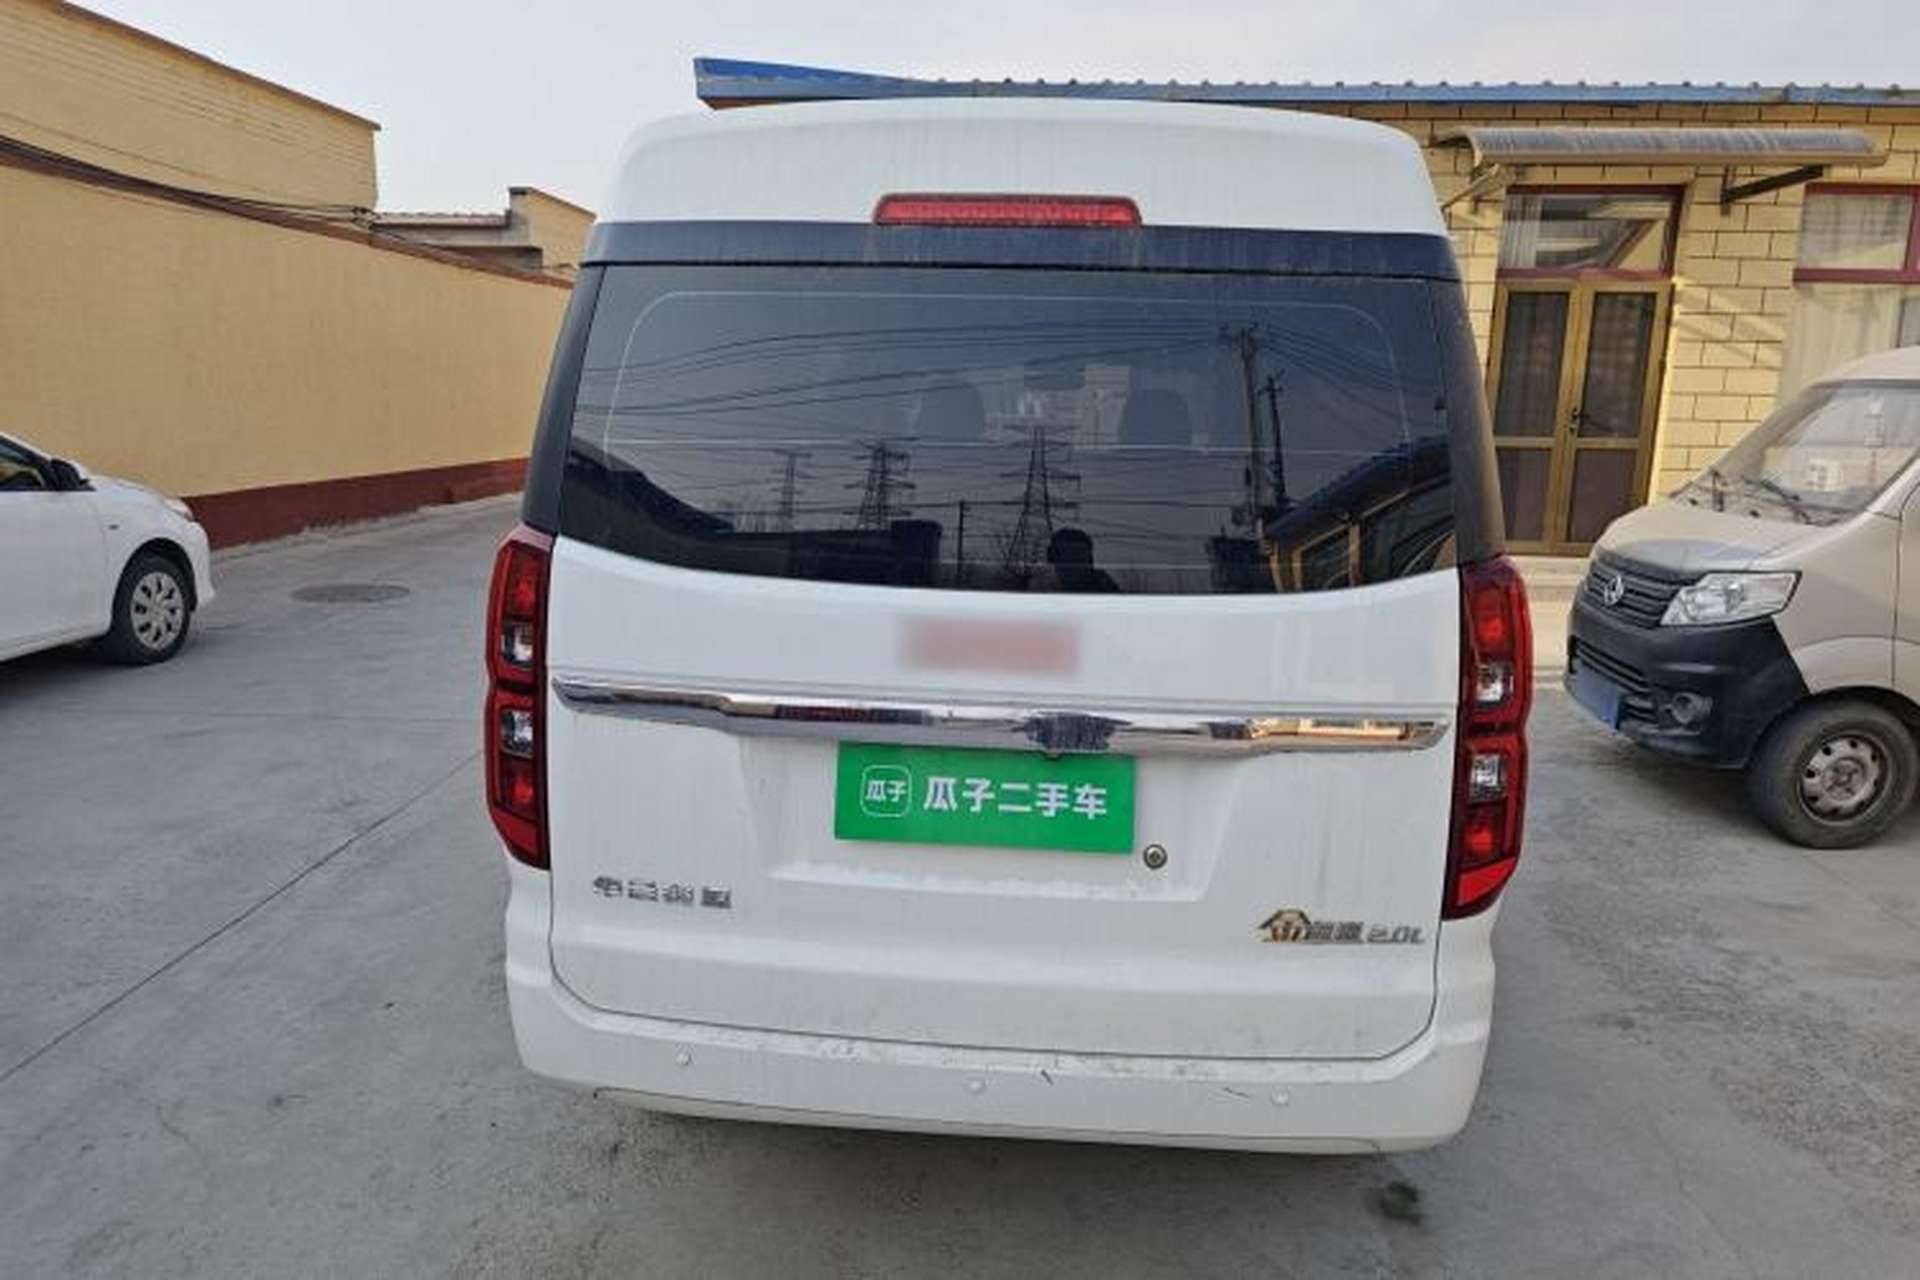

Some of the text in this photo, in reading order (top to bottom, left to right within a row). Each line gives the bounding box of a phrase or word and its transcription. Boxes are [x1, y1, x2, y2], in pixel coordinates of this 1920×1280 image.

[865, 780, 906, 802] 瓜子
[923, 776, 1108, 819] 瓜子二手车
